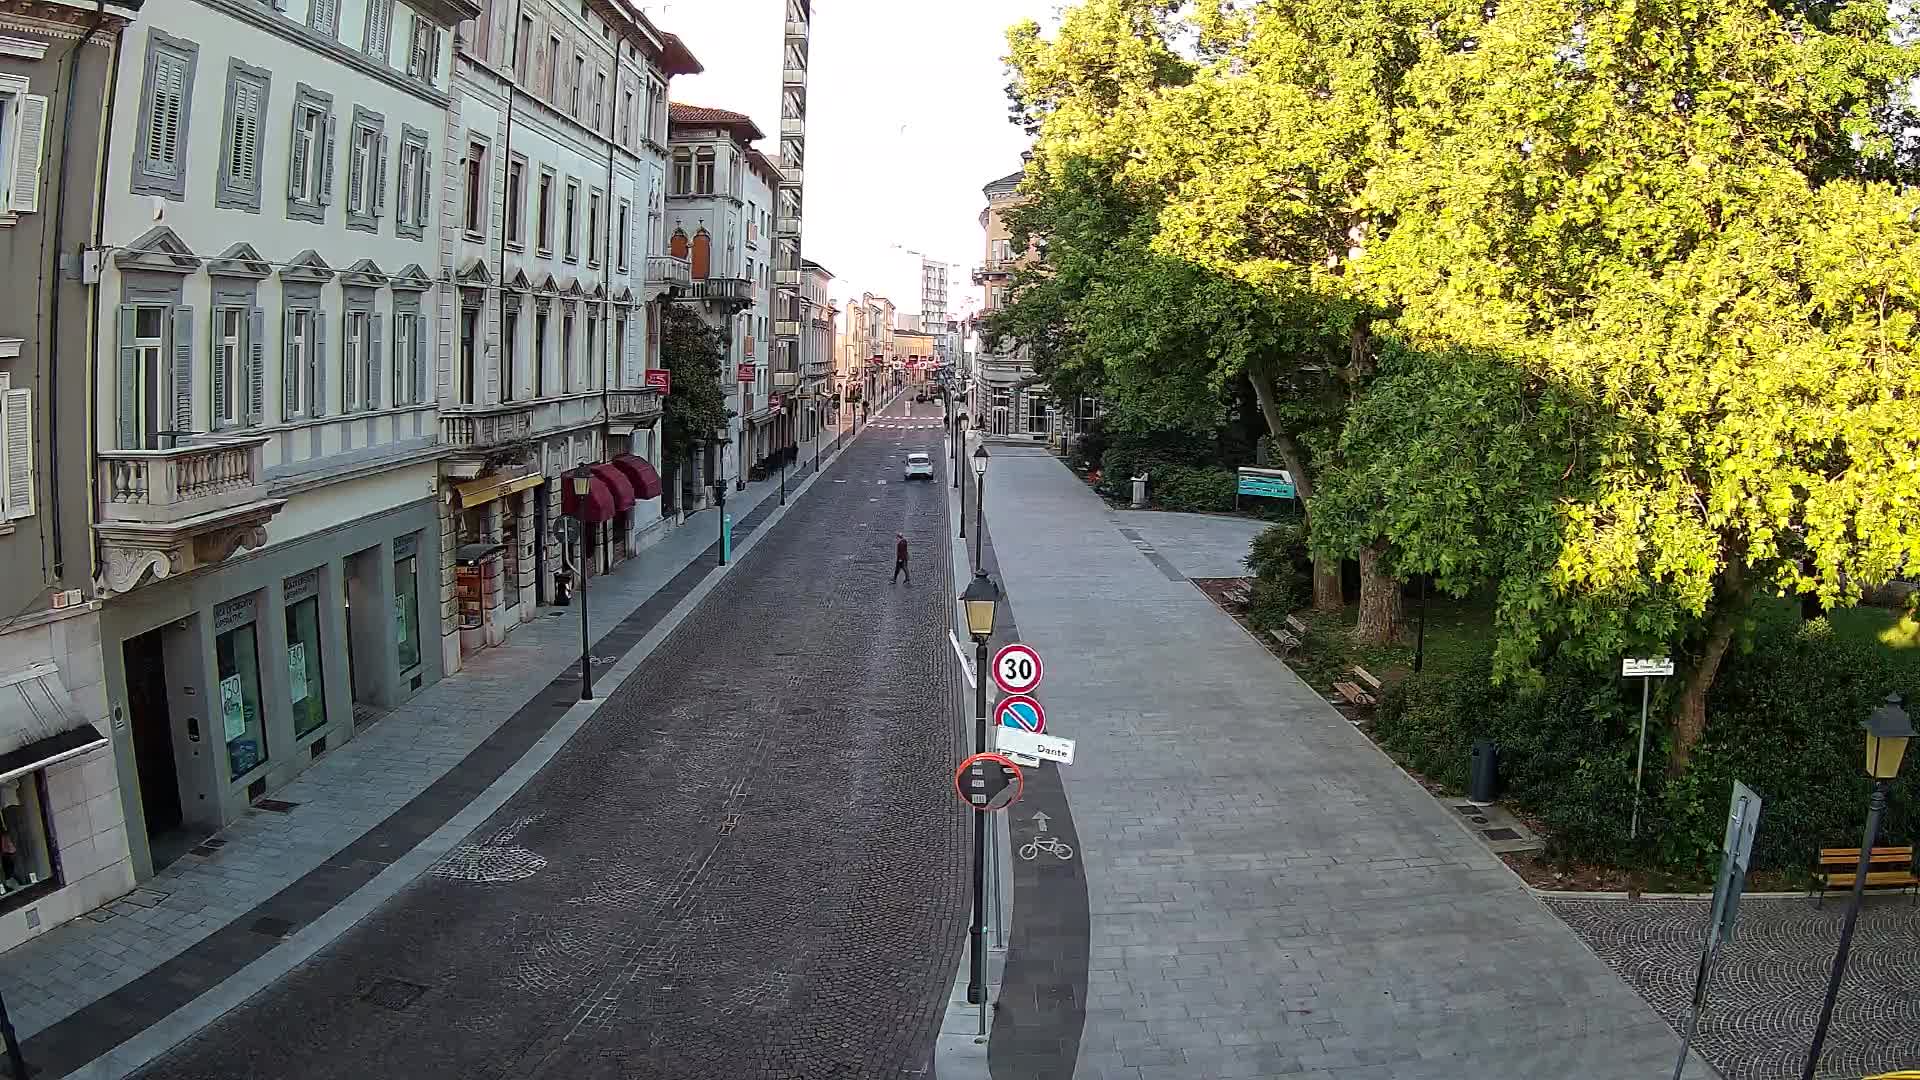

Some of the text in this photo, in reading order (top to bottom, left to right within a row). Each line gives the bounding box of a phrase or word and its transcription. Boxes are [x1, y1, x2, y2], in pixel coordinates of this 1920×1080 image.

[1005, 658, 1032, 680] 30
[222, 677, 240, 701] 130
[1037, 744, 1068, 758] Dante
